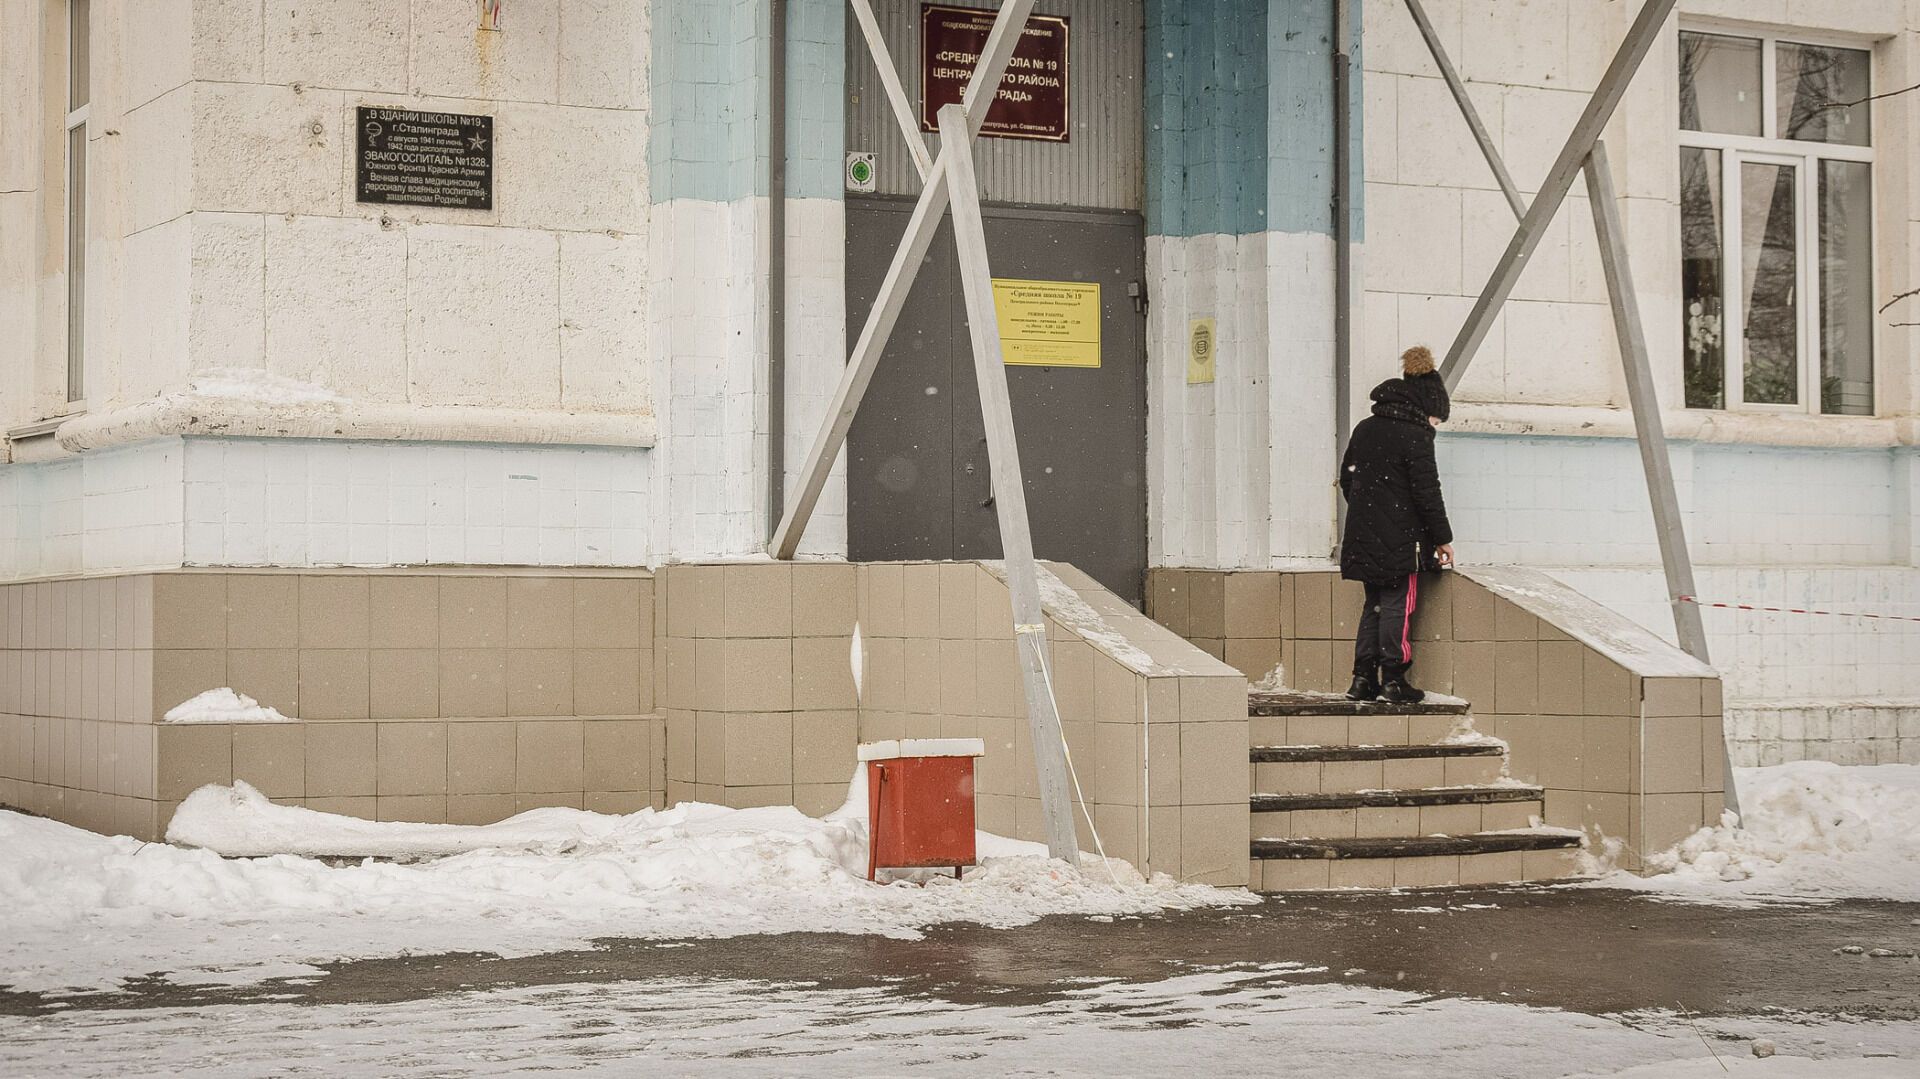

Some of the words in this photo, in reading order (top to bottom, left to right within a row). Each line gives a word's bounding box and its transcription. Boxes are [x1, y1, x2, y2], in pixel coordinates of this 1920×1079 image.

[942, 21, 992, 31] ОБЩЕОБРАЗОВАТ
[1022, 27, 1053, 37] РЕЖДЕНИЕ
[1008, 56, 1031, 68] ОЛА
[1032, 58, 1045, 69] №
[1046, 60, 1057, 71] 19
[1018, 73, 1060, 88] РАЙОНА
[370, 109, 378, 119] В
[379, 110, 420, 122] ЗДАНИИ
[420, 112, 458, 125] ШКОЛЫ
[392, 122, 460, 137] г.Сталинграда
[387, 142, 404, 151] 1942
[364, 150, 454, 166] ЭВАКОГОСПИТАЛЬ
[365, 160, 397, 171] Южного
[397, 163, 426, 173] Фронта
[427, 165, 459, 175] Красной
[460, 167, 486, 177] Армии
[370, 171, 399, 182] Вечная
[400, 175, 424, 184] слава
[424, 177, 481, 189] медицинскому
[365, 182, 407, 194] персоналу
[407, 185, 441, 194] военных
[1074, 292, 1082, 300] 19
